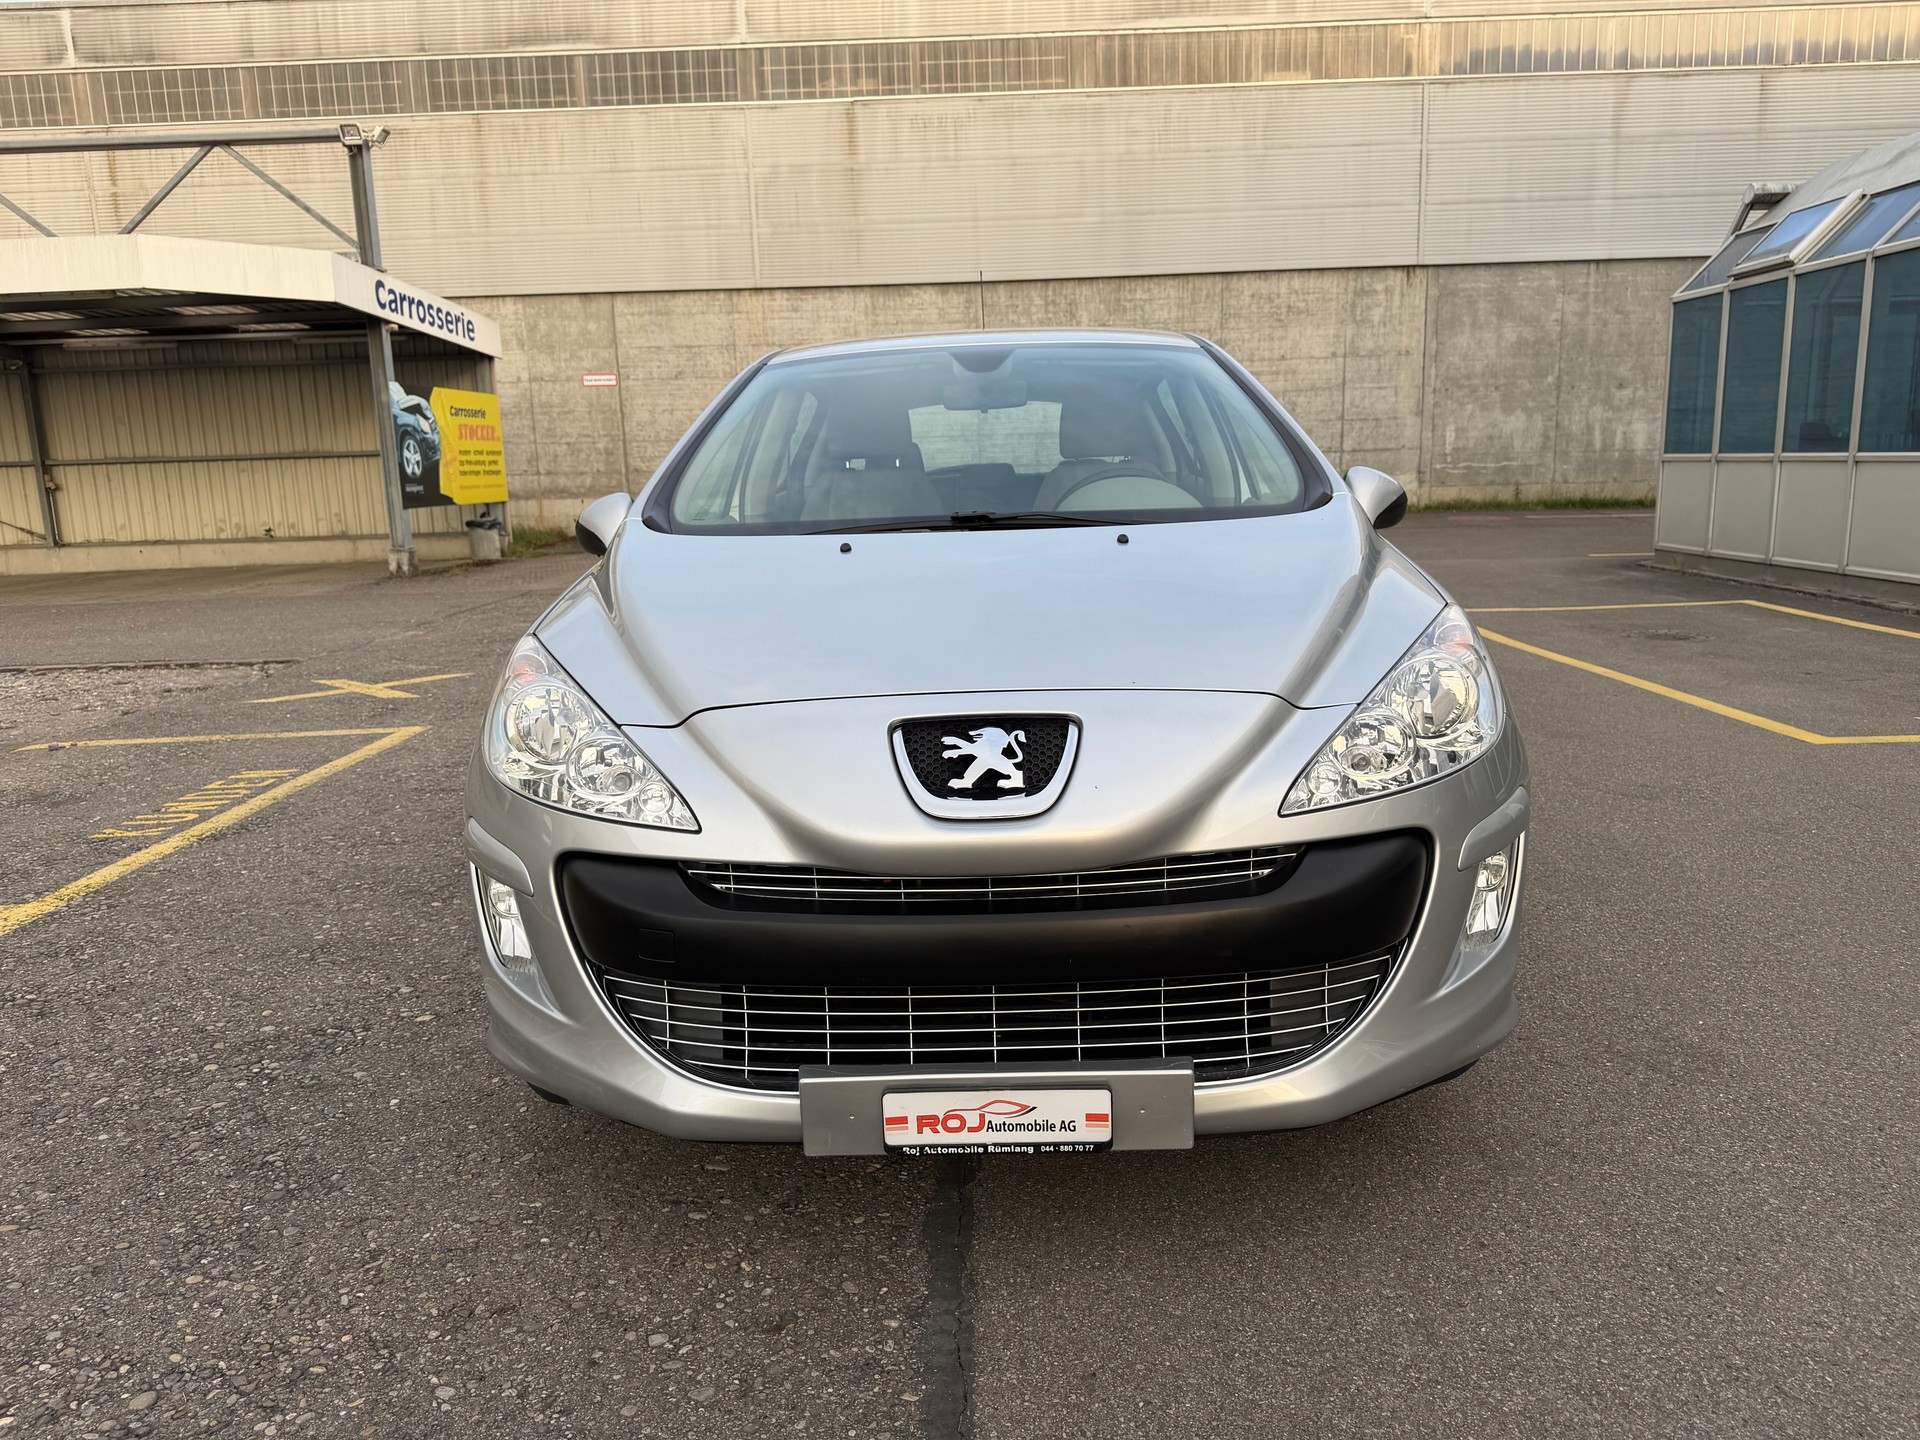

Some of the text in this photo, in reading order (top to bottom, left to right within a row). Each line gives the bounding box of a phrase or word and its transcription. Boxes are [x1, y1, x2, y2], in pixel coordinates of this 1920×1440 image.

[375, 279, 476, 342] Carrosserie
[450, 405, 487, 420] Carrosserie
[916, 1112, 1077, 1135] ROJ Automobile AG
[902, 1146, 920, 1156] Roj
[923, 1145, 985, 1155] Automobile
[987, 1144, 1035, 1154] Rümlang
[1040, 1144, 1054, 1152] 044
[1059, 1144, 1073, 1152] 880
[1074, 1144, 1084, 1152] 70
[1085, 1144, 1095, 1152] 77
